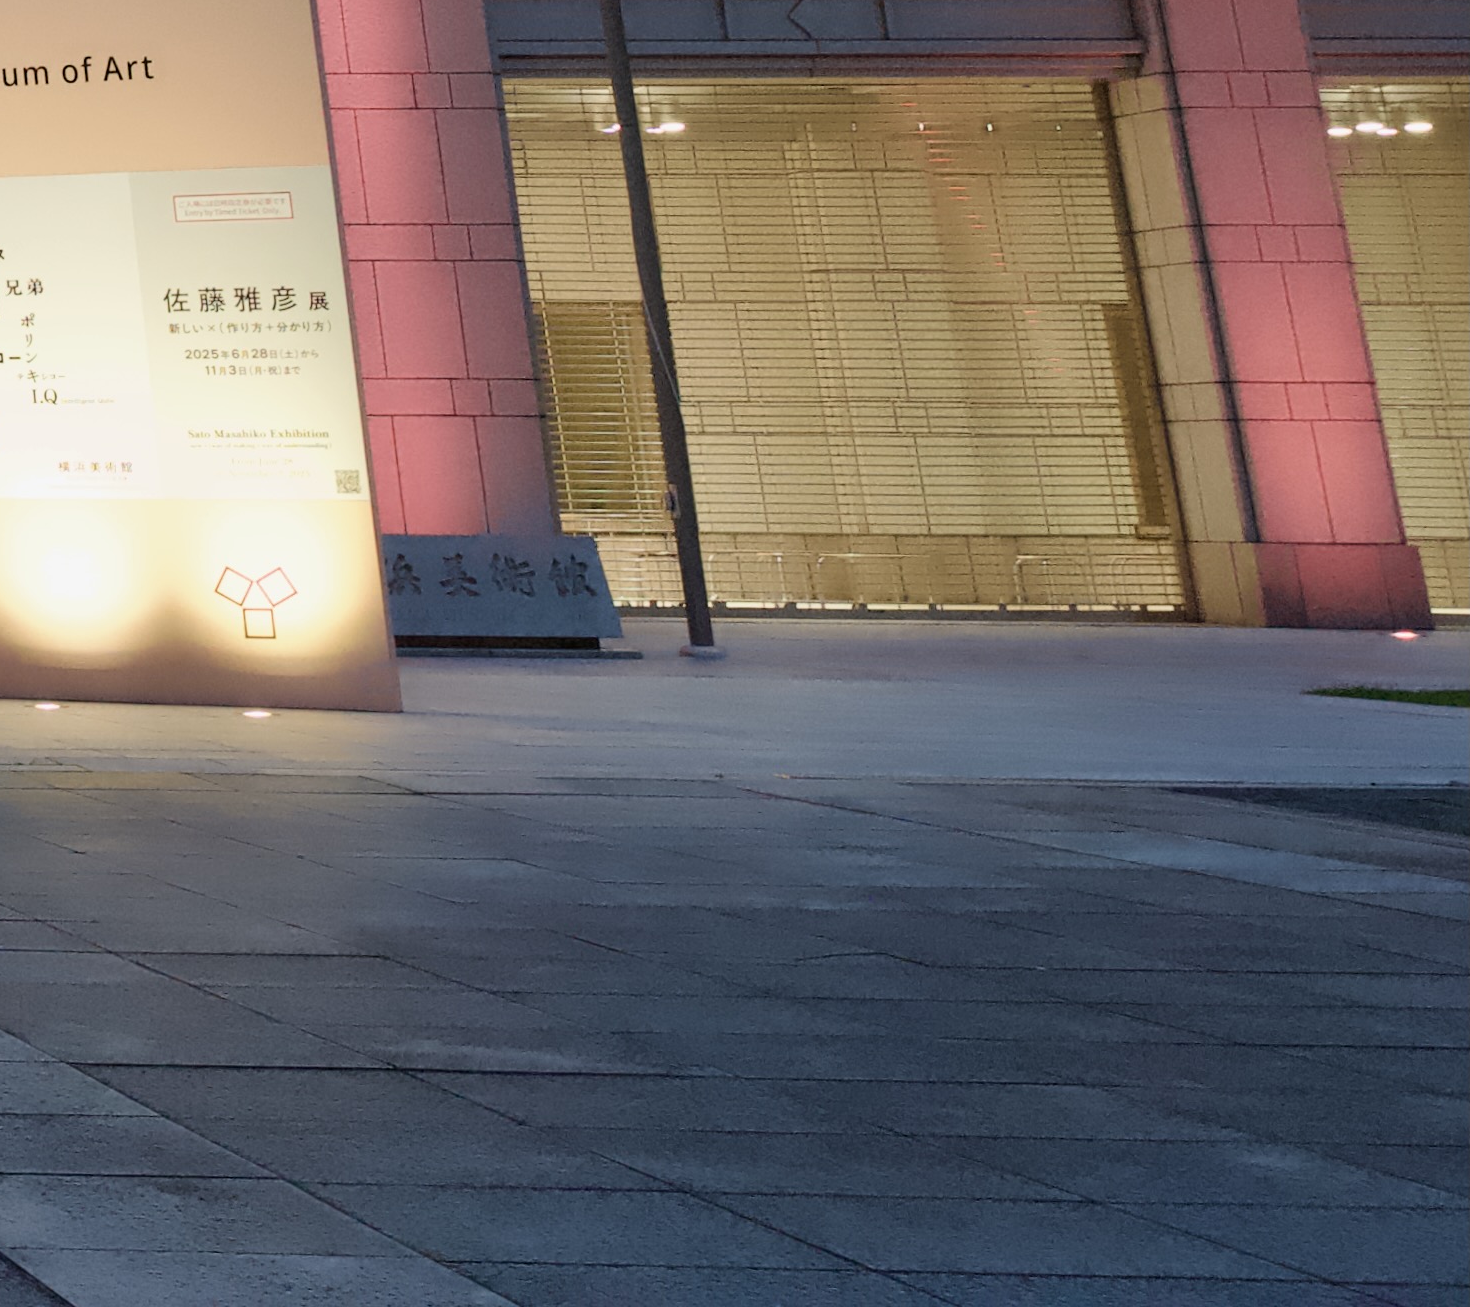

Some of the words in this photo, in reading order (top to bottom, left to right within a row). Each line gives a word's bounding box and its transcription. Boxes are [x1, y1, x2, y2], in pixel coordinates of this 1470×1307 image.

[62, 56, 93, 84] of
[104, 55, 156, 83] Art
[163, 285, 330, 314] 佐藤雅彦展
[187, 429, 211, 439] Sato
[214, 429, 267, 439] Masahiko
[270, 428, 330, 439] Exhibition
